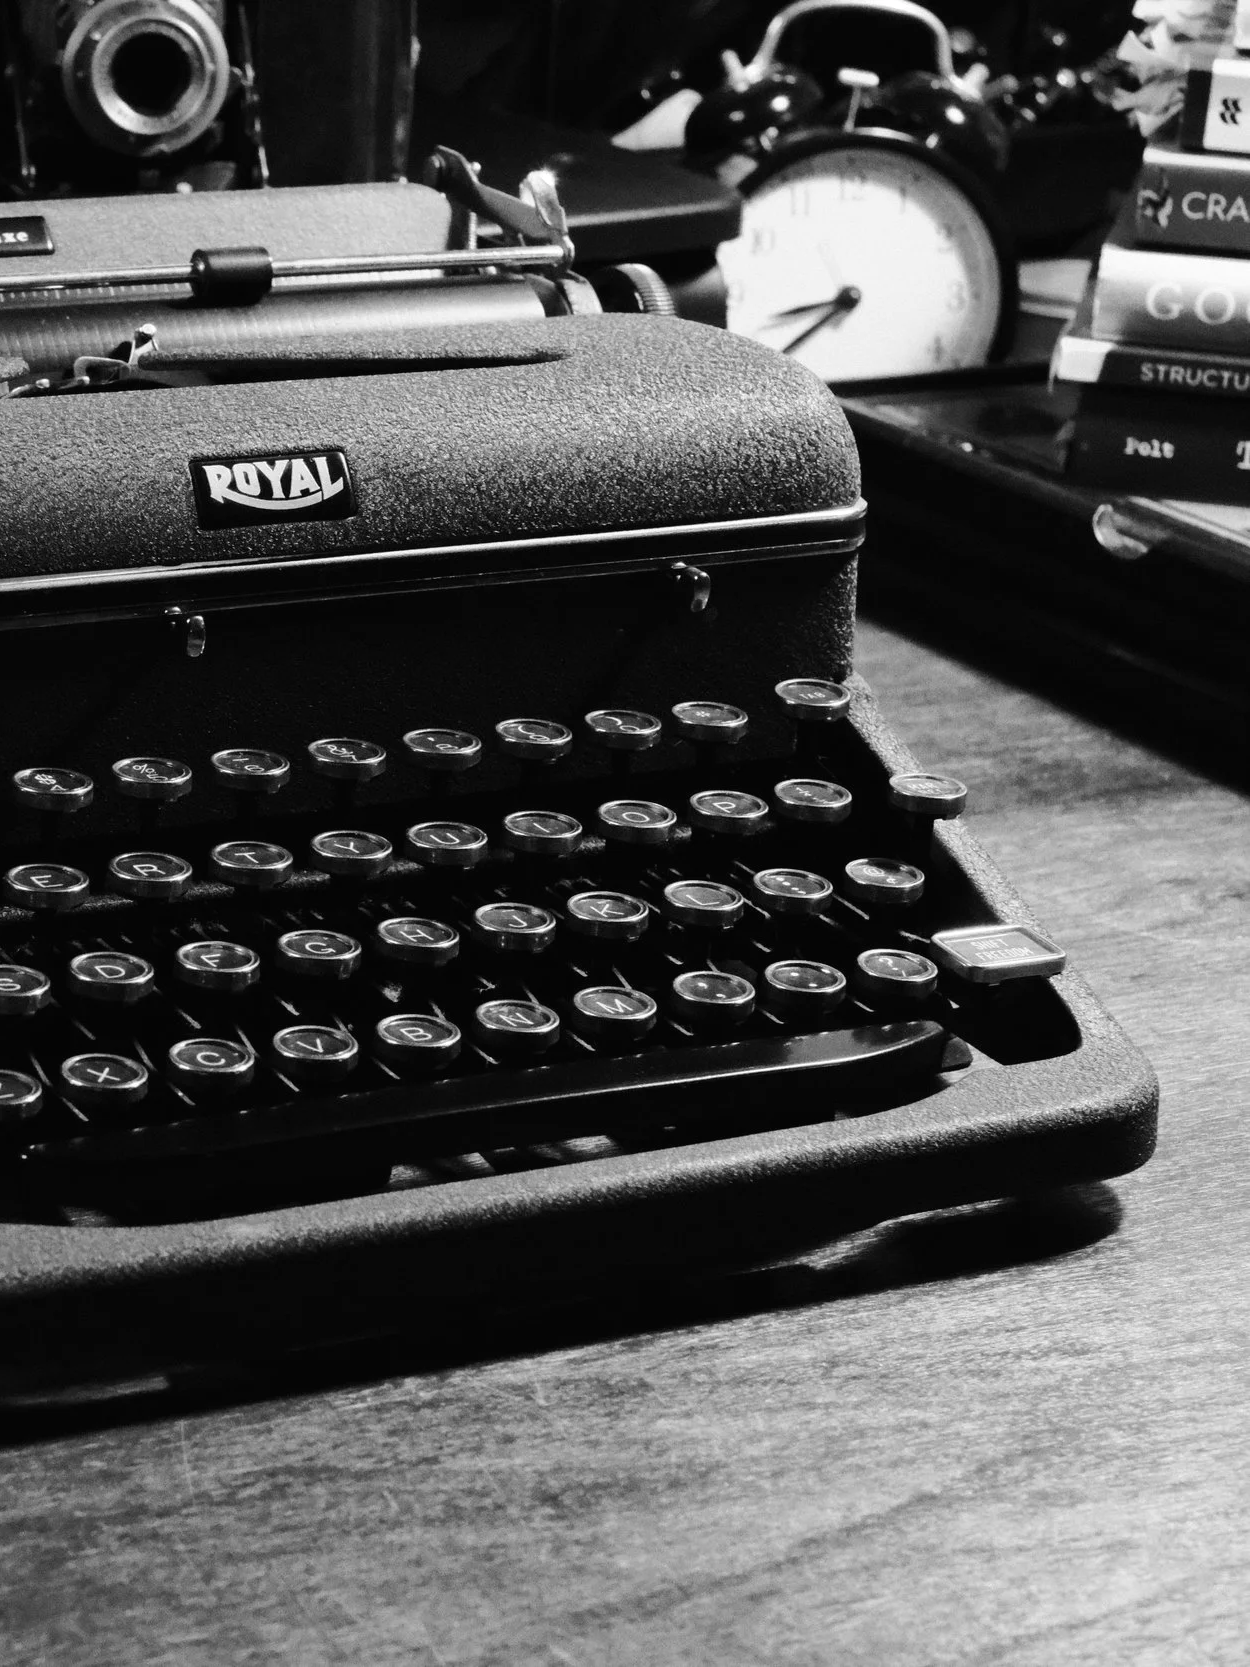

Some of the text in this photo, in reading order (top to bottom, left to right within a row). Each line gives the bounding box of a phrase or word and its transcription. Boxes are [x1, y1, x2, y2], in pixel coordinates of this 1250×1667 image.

[1146, 281, 1250, 326] GO
[1140, 362, 1250, 392] STRUCTU
[202, 457, 344, 510] ROYAL
[799, 691, 826, 700] TAB
[712, 801, 737, 814] P
[621, 811, 651, 824] O
[429, 832, 462, 846] U
[333, 840, 361, 854] Y
[233, 851, 260, 864] T
[132, 863, 167, 876] R
[30, 874, 64, 888] E
[684, 892, 720, 906] L
[590, 902, 626, 918] K
[508, 914, 528, 928] J
[399, 928, 436, 943] H
[304, 941, 337, 955] G
[970, 939, 1009, 951] SHIFT
[200, 953, 224, 968] F
[975, 947, 1034, 961] FREEDOM
[94, 964, 126, 978] D
[595, 999, 634, 1015] M
[499, 1011, 535, 1028] N
[398, 1025, 434, 1042] B
[296, 1037, 324, 1054] V
[196, 1051, 226, 1067] C
[85, 1065, 121, 1083] X
